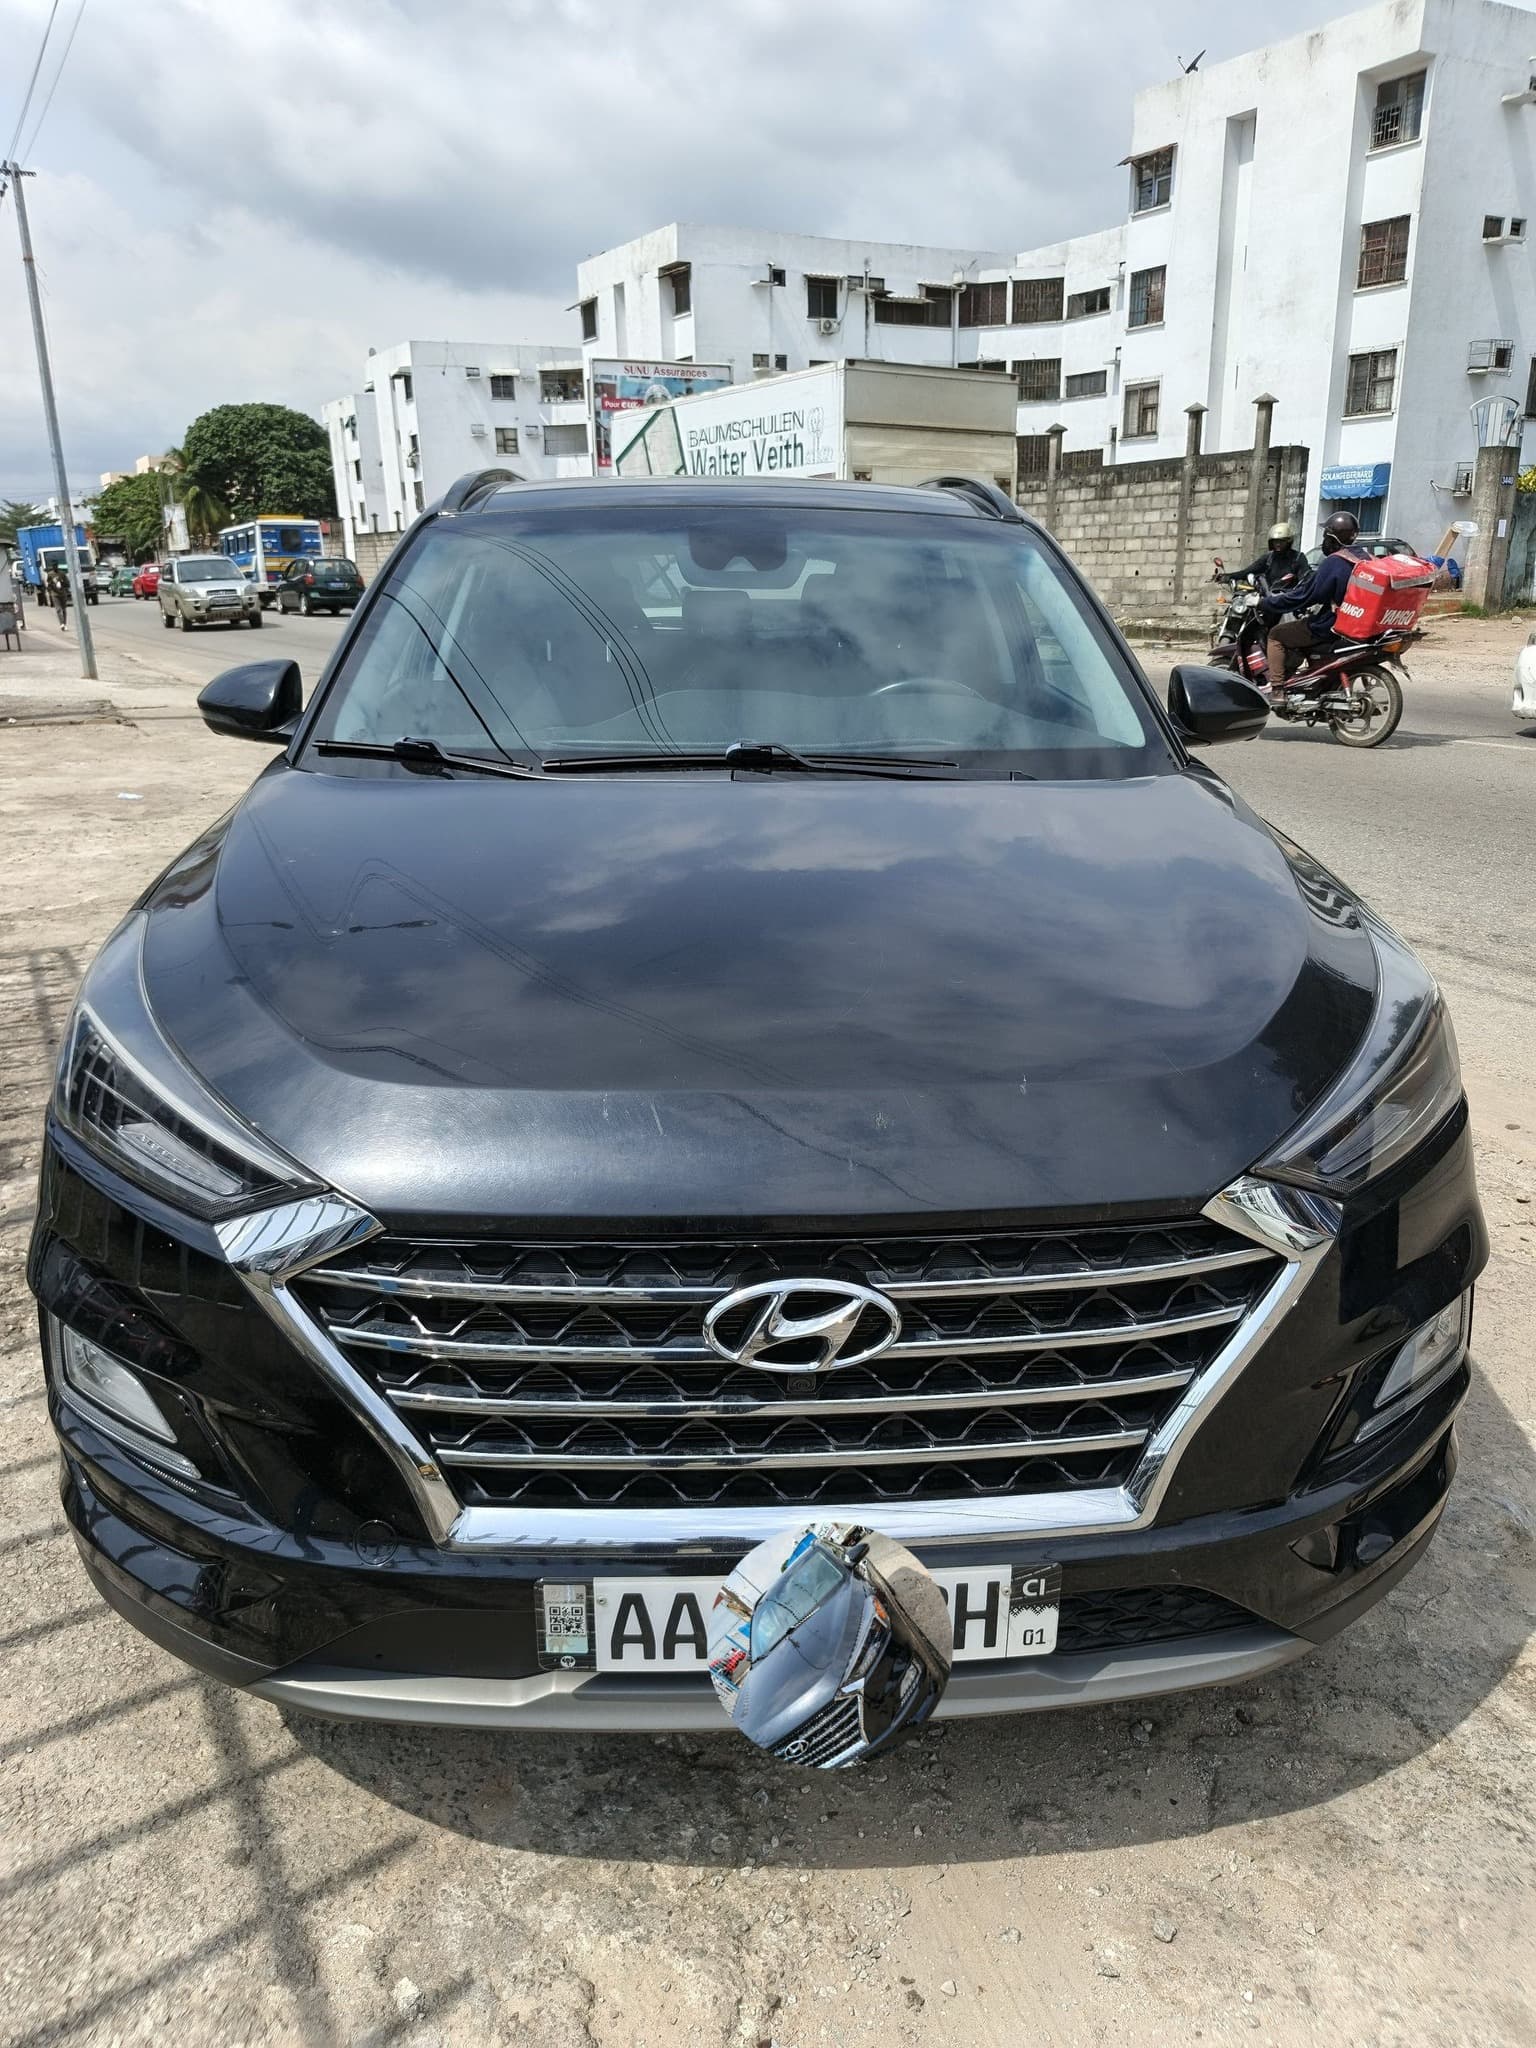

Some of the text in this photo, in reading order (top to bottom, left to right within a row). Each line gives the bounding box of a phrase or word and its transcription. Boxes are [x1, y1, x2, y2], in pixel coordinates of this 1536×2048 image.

[623, 365, 708, 378] SUNU Assurances
[688, 408, 805, 448] BAUMSCHULEN
[690, 433, 804, 476] Walter Veith
[1380, 609, 1416, 626] YANGO
[1022, 1578, 1046, 1597] CI
[611, 1592, 708, 1660] AA
[1022, 1628, 1046, 1646] 01
